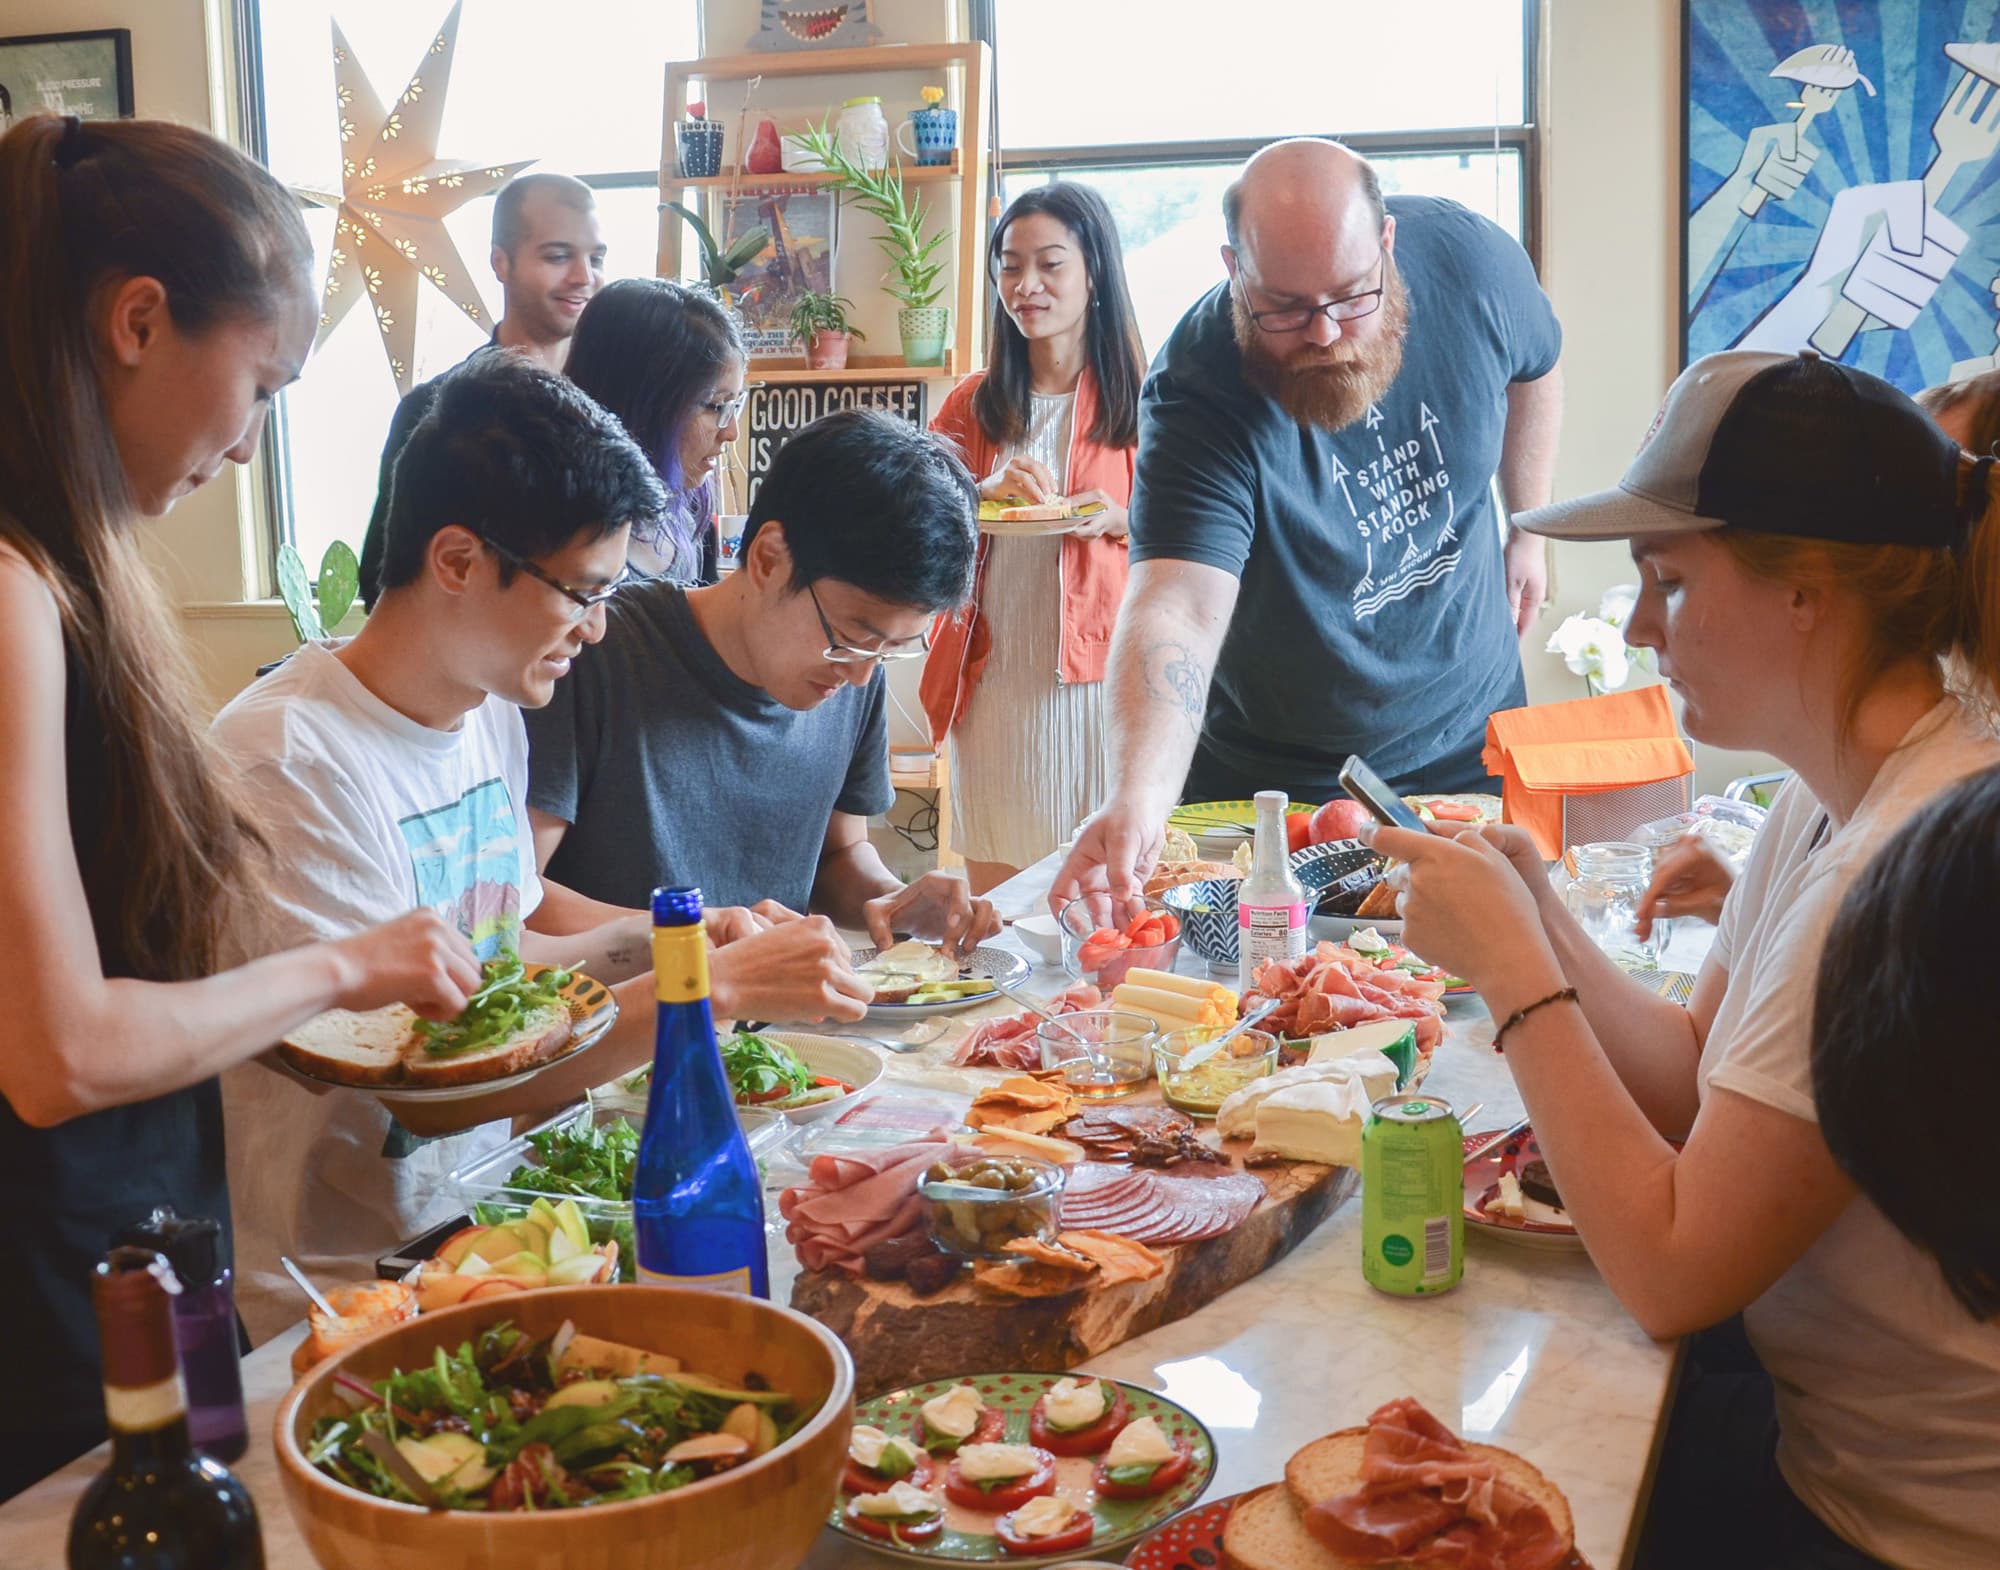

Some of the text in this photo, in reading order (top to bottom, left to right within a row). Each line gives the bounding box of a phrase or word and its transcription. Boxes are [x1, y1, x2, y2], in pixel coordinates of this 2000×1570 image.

[752, 388, 816, 431] GOOD
[750, 437, 771, 472] IS
[1356, 440, 1421, 487] STAND
[1369, 461, 1421, 501] WITH
[1356, 470, 1450, 537] STANDING
[1381, 501, 1432, 543] ROCK
